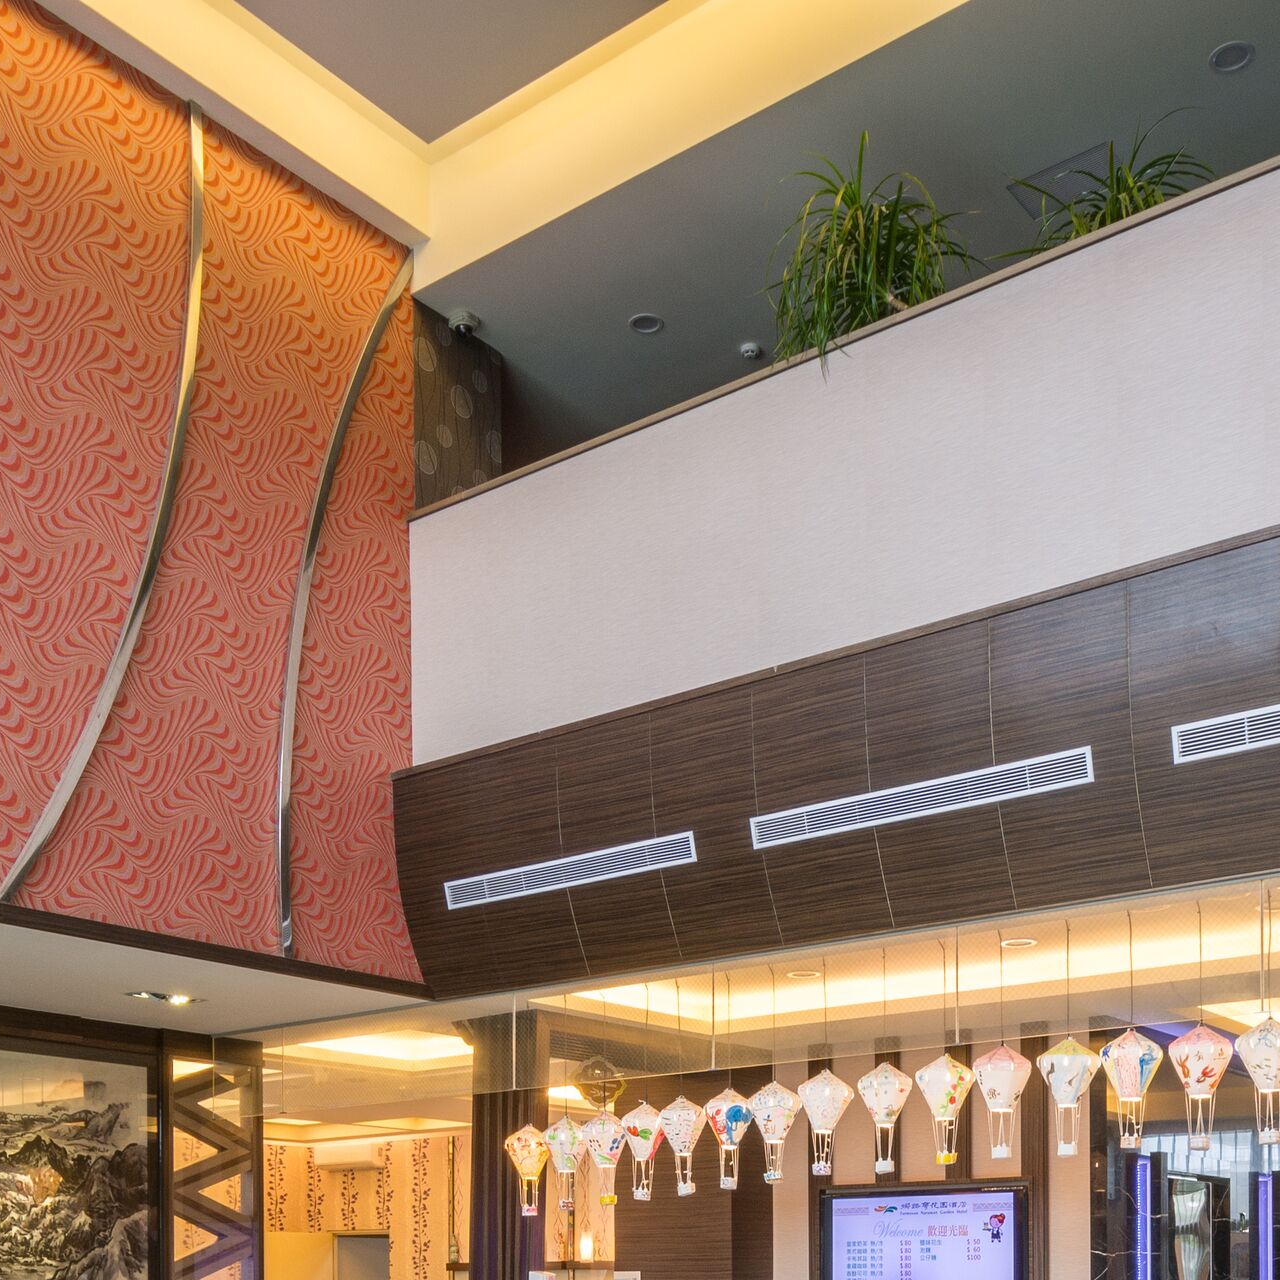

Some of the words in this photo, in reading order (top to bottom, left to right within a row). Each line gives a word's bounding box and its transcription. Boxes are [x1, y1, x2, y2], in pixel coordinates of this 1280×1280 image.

[873, 1218, 924, 1238] Welcome
[927, 1224, 968, 1237] 歡迎光臨
